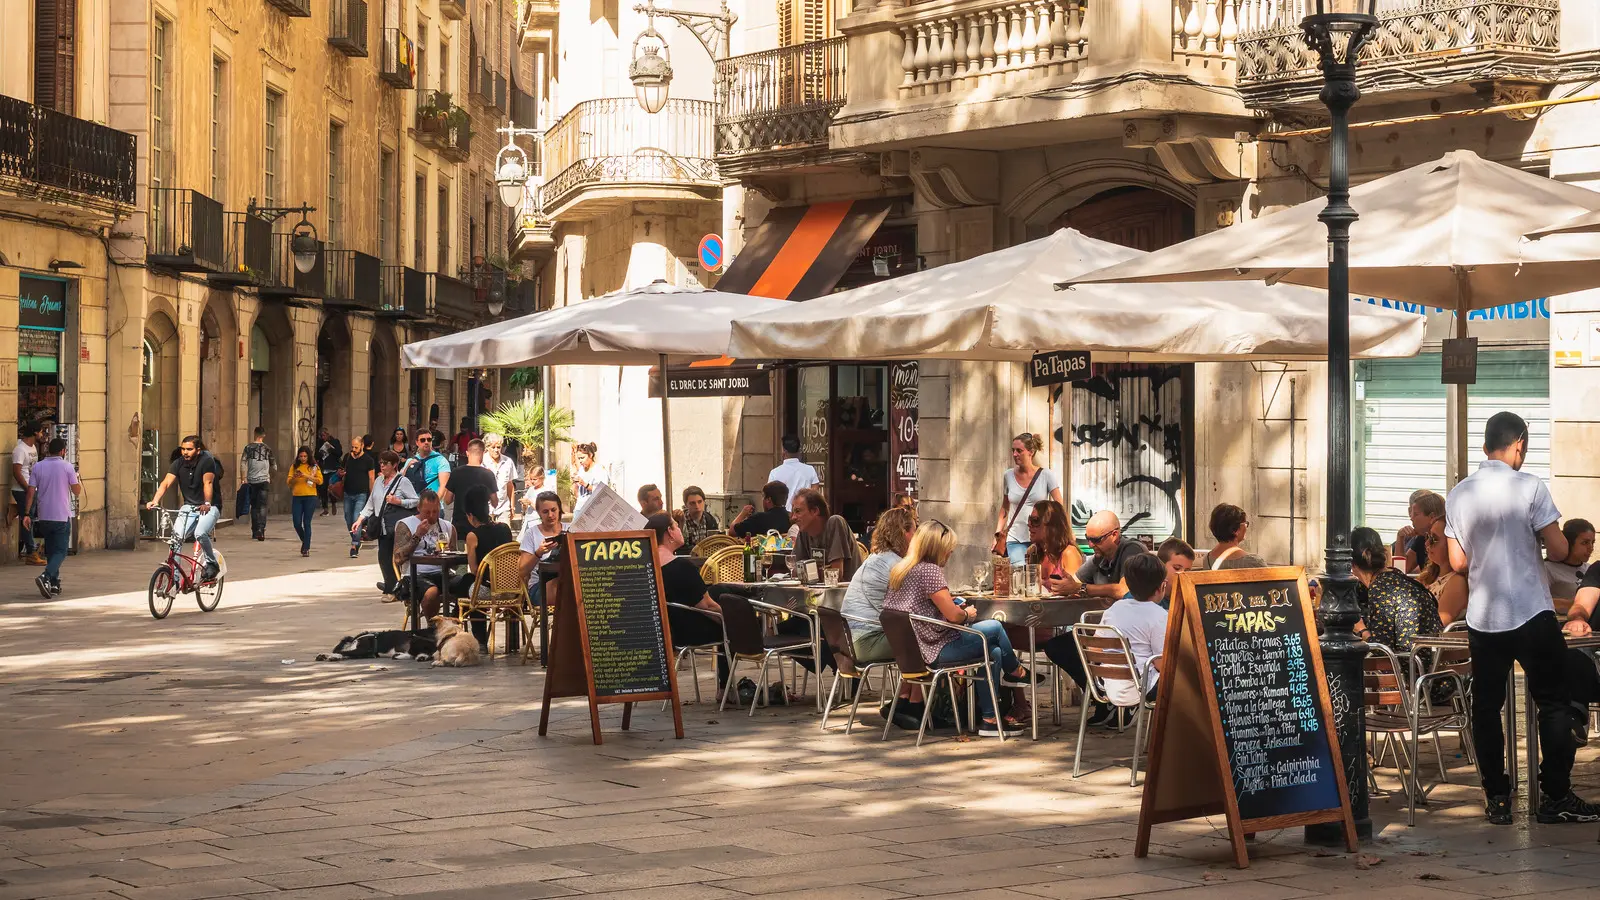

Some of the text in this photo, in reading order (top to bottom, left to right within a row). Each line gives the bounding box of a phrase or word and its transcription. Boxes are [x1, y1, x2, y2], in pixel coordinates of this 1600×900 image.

[1453, 297, 1550, 320] AMBI
[670, 377, 749, 390] EL DRAC DE SANT JORDI
[580, 540, 642, 561] TAPAS
[1203, 592, 1246, 613] BAR
[1268, 588, 1292, 608] PI
[1225, 611, 1276, 633] TAPAS
[1214, 633, 1301, 651] Patatas Bravas 3.65
[1216, 649, 1255, 664] Croquetas
[1286, 645, 1303, 658] 1.85
[1217, 658, 1306, 677] Tortilla Española 3.95
[1222, 676, 1233, 690] La
[1235, 675, 1258, 688] Bomba
[1288, 670, 1309, 683] 2.45
[1262, 686, 1289, 698] Romana
[1289, 683, 1308, 695] 4.95
[1225, 701, 1243, 715] Pulpo
[1250, 700, 1257, 712] la
[1258, 699, 1286, 716] Gallega
[1291, 695, 1313, 708] 13.65
[1228, 713, 1252, 727] Huevos
[1251, 711, 1270, 723] Fritos
[1278, 710, 1298, 722] Bacon
[1298, 708, 1315, 719] 6.90
[1300, 719, 1319, 732] 4.95
[1264, 734, 1301, 749] Artesanal
[1288, 770, 1317, 784] Colada
